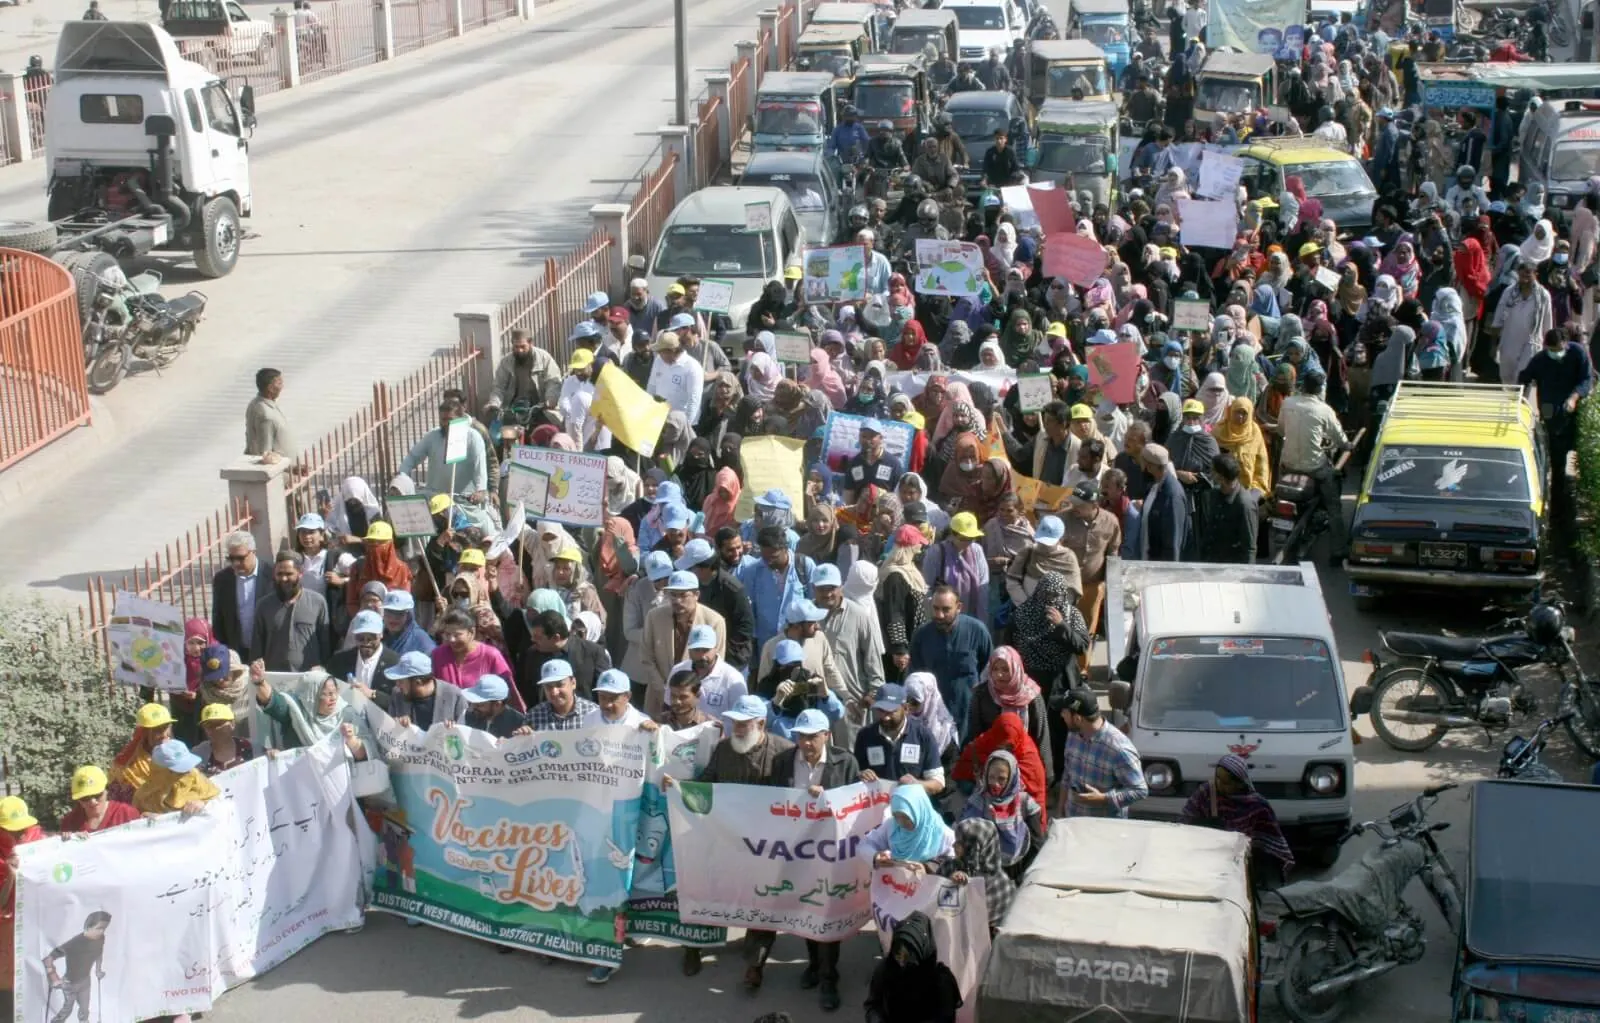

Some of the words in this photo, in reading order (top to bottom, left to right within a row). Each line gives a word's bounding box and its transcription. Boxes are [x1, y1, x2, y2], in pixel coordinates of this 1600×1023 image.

[545, 452, 565, 463] FREE
[376, 728, 408, 752] unicef
[504, 746, 541, 764] Gavi
[451, 763, 505, 777] OGRAM
[510, 766, 532, 777] ON
[538, 762, 645, 779] IMMUNIZATION
[577, 772, 620, 788] SINDH
[429, 788, 569, 849] Vaccines
[497, 847, 581, 909] Lives
[377, 892, 422, 913] DISTRICT
[423, 903, 450, 922] WEST
[450, 912, 492, 935] KARACHI
[499, 927, 544, 945] DISTRICT
[544, 935, 584, 954] HEALTH
[586, 943, 623, 961] OFFICE
[634, 919, 667, 932] WEST
[669, 923, 721, 940] KARACHI
[1055, 956, 1169, 989] SAZGAR
